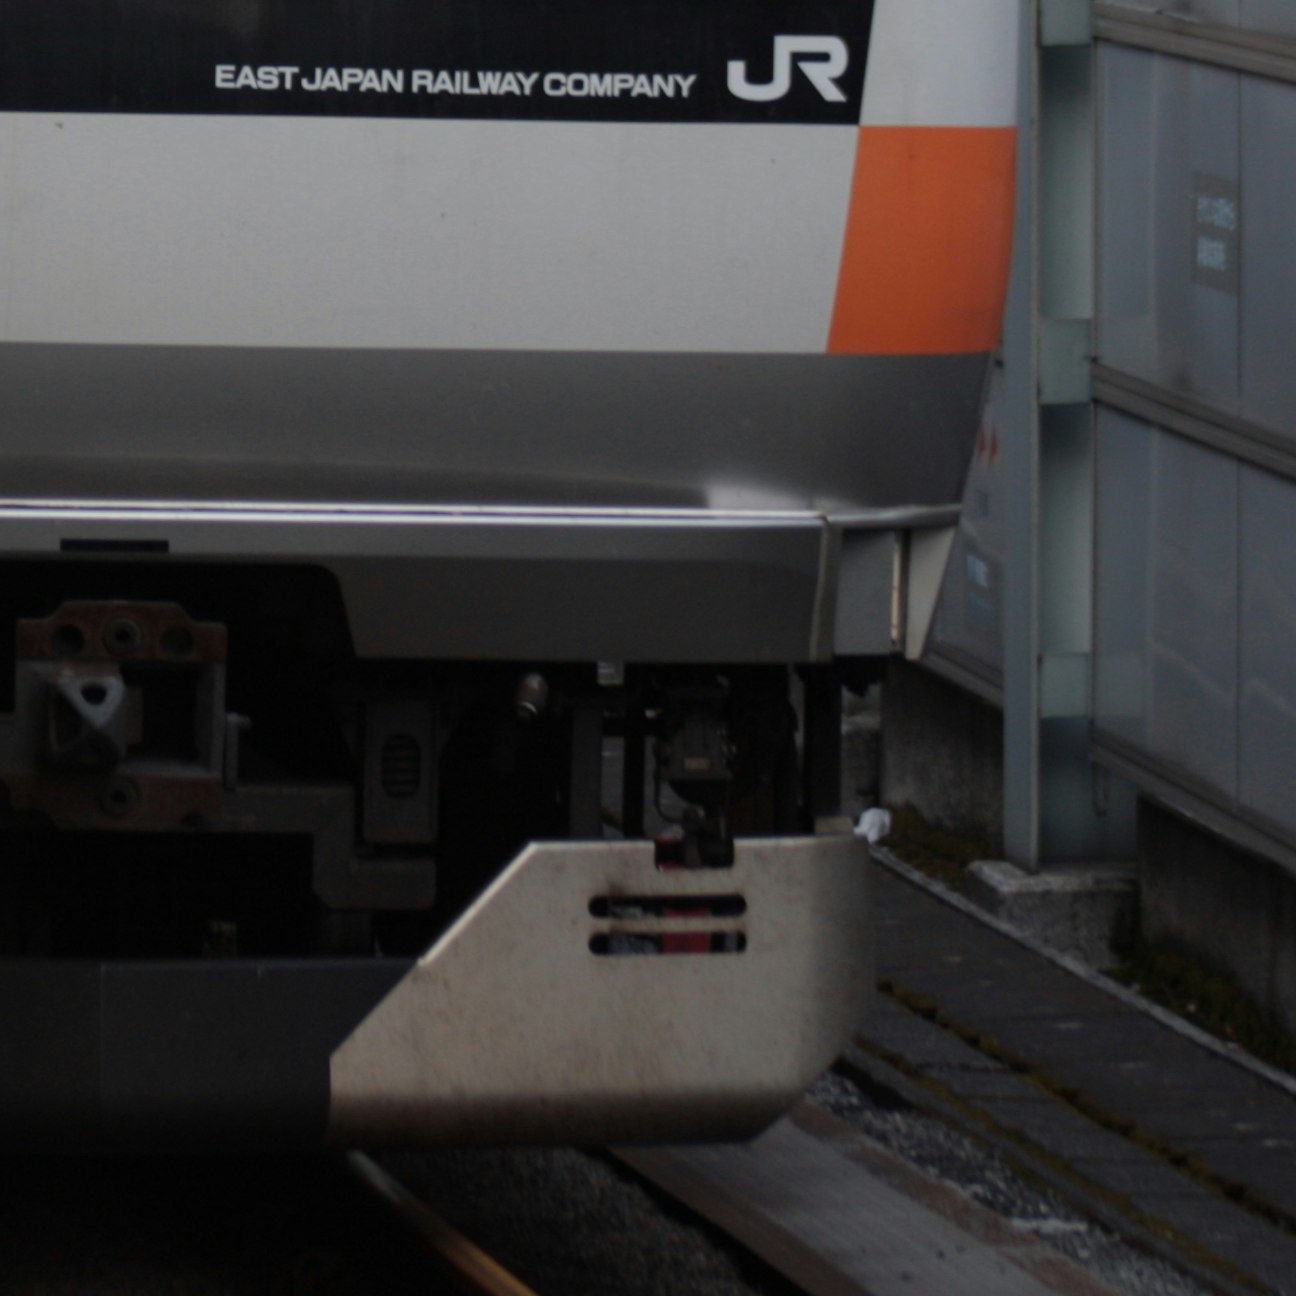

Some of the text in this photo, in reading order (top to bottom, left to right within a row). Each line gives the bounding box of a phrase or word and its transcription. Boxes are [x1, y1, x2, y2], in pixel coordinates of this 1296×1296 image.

[214, 64, 697, 99] EAST JAPAN RAILWAY COMPANY
[727, 34, 850, 103] JR
